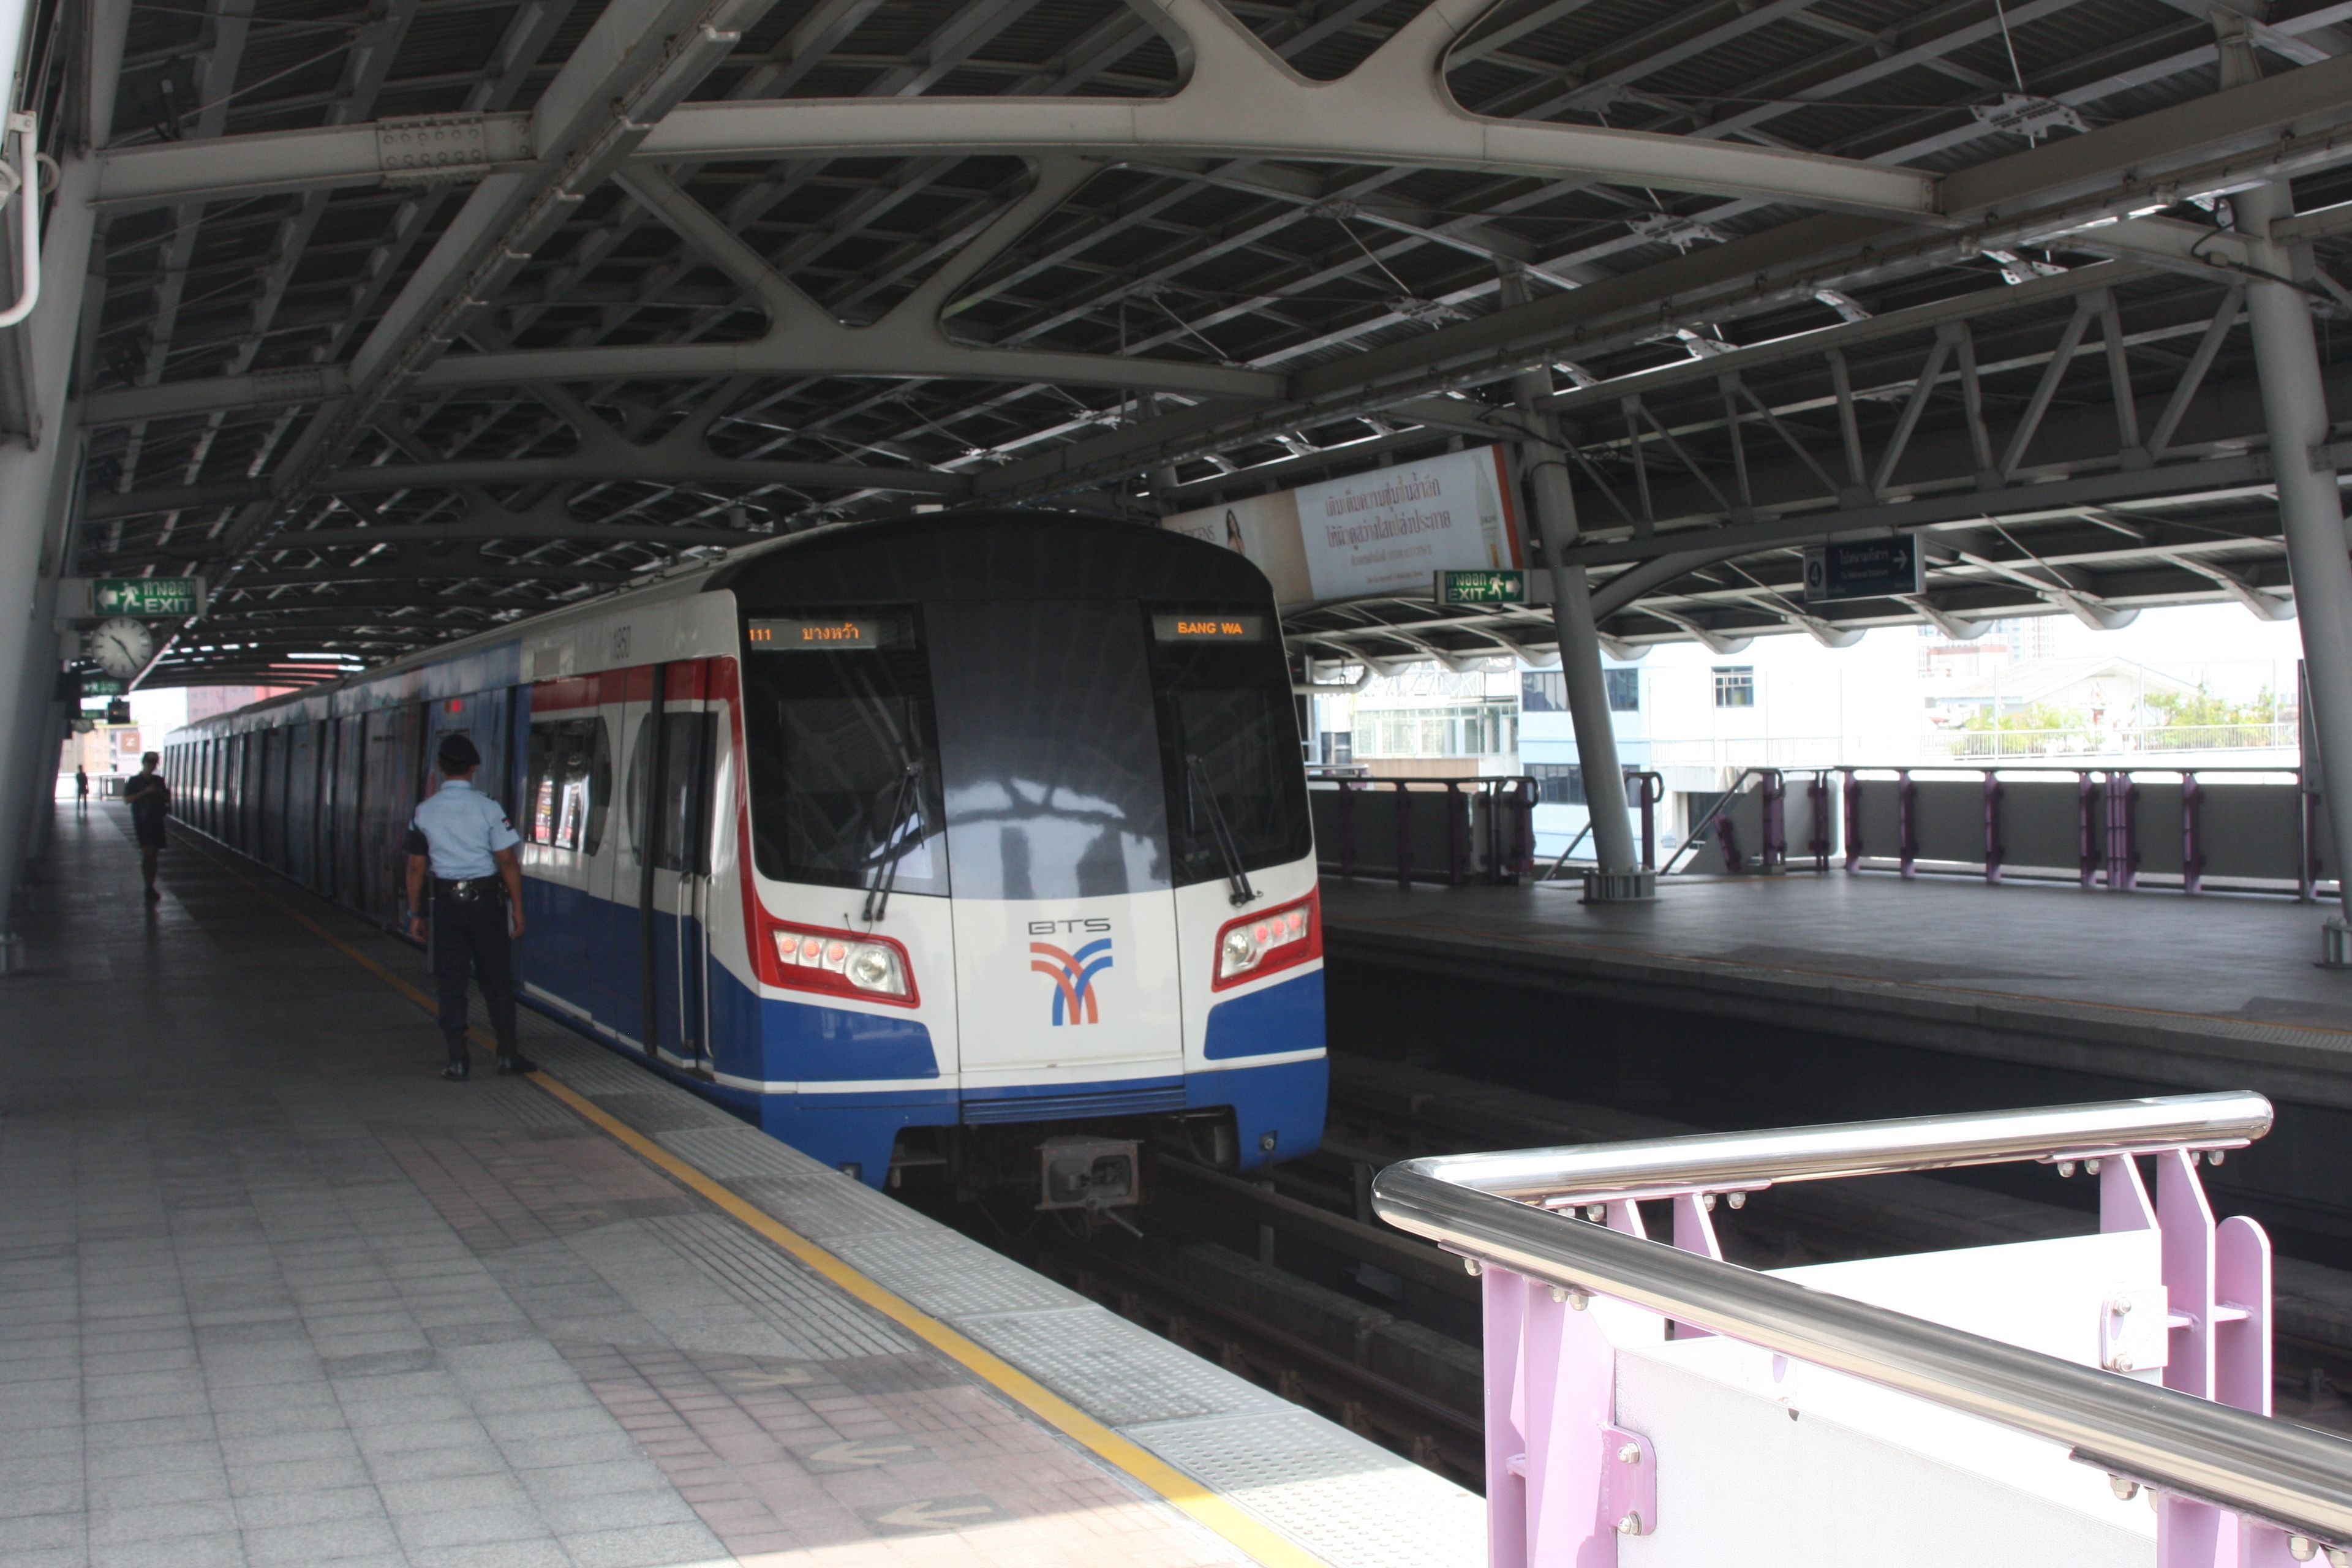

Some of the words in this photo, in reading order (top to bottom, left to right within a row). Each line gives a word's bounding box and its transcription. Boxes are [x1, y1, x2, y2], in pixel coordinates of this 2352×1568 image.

[1447, 573, 1487, 586] ทางออก
[143, 581, 195, 596] ทางออก
[1447, 588, 1485, 600] EXIT
[145, 598, 192, 612] EXIT
[802, 622, 860, 640] บางหว้า
[1177, 622, 1216, 634] BANG
[1221, 622, 1243, 635] WA
[1028, 918, 1111, 935] BTS
